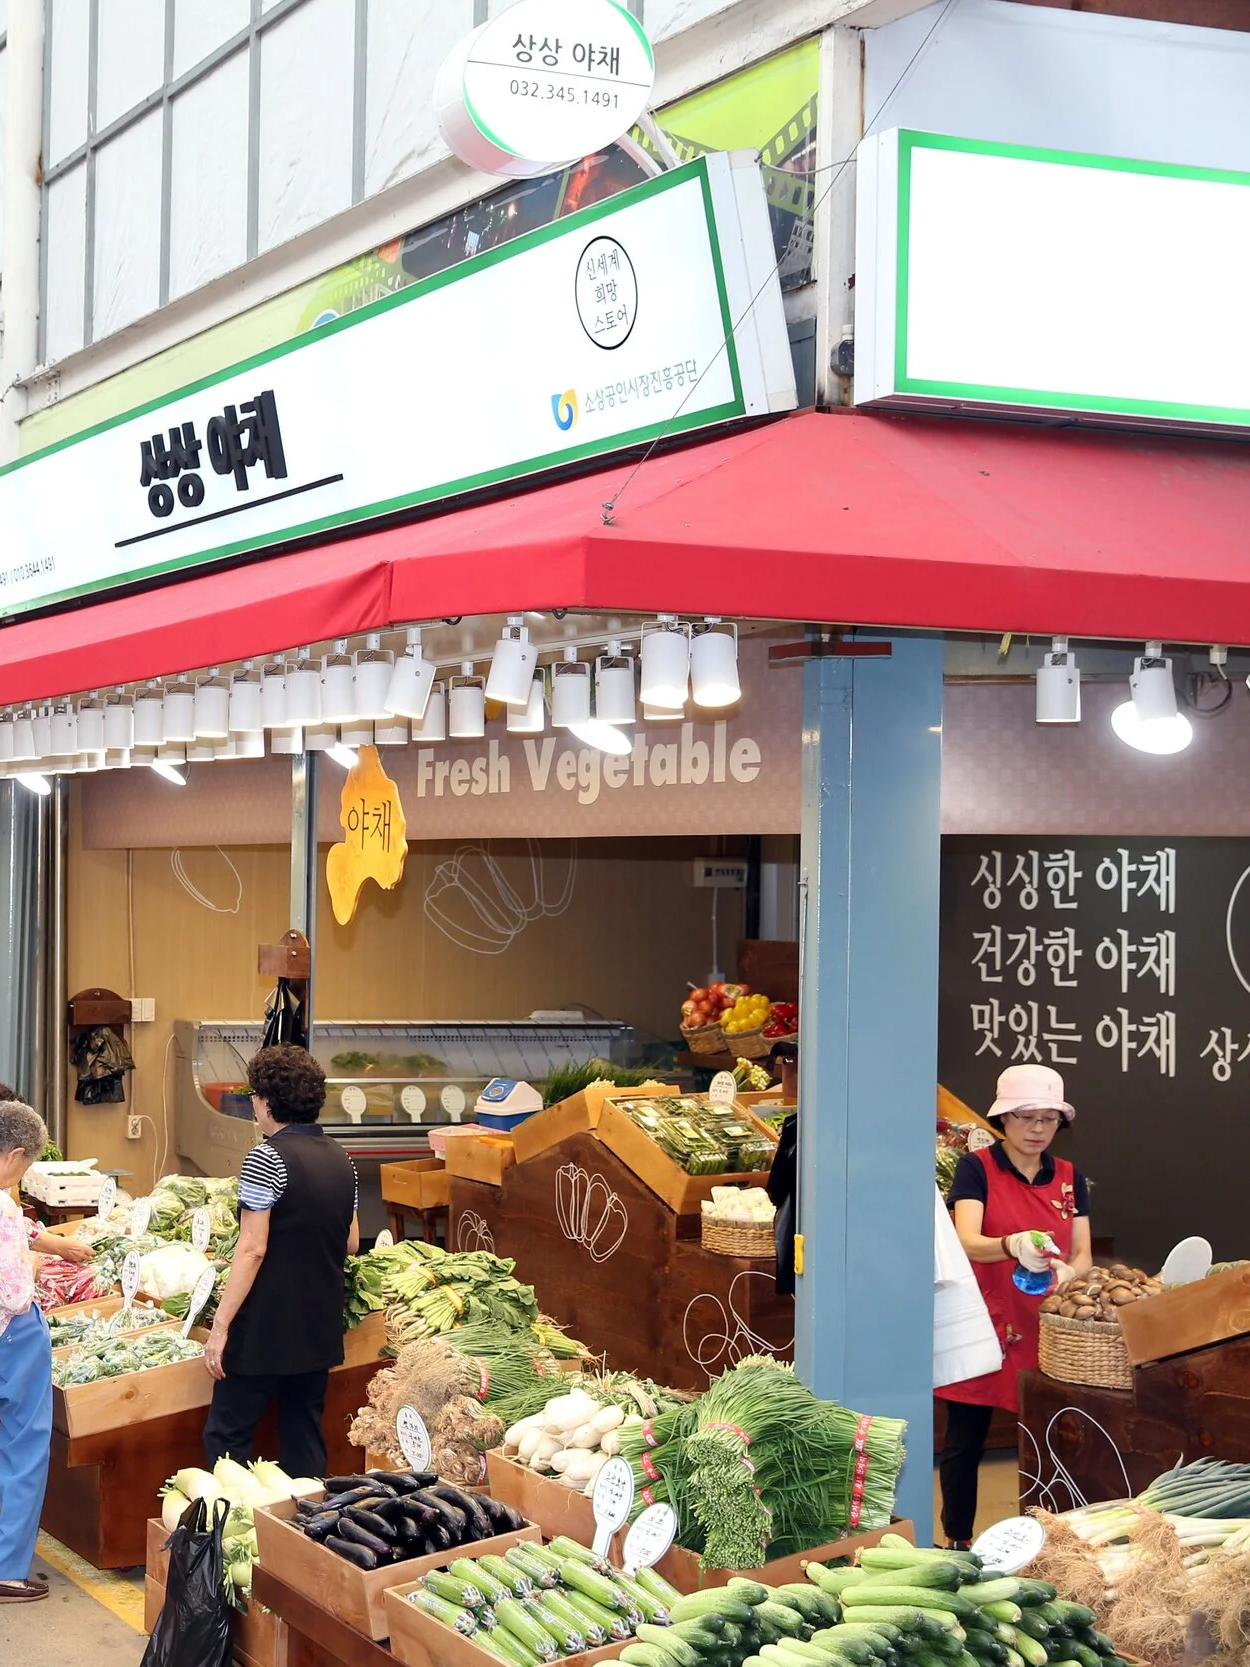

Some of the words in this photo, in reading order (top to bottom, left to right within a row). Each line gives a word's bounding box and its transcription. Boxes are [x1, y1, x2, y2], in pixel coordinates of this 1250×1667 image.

[512, 33, 563, 67] 상상
[572, 42, 620, 76] 야채
[510, 79, 619, 109] 032.345.1491
[585, 248, 621, 281] 신세계
[594, 278, 618, 304] 희망
[593, 303, 629, 334] 스토어
[584, 358, 699, 414] 소상공인시장진흥공단
[139, 420, 205, 518] 상상
[206, 388, 288, 492] 야채
[416, 739, 511, 798] Fresh
[522, 719, 763, 806] Vegetable
[347, 797, 393, 853] 야채
[970, 848, 1083, 911] 싱싱한
[1095, 847, 1177, 914] 야채
[970, 924, 1083, 988] 건강한
[1095, 928, 1177, 997] 야채
[969, 997, 1083, 1065] 맛있는
[1095, 1006, 1177, 1079] 야채
[1199, 1026, 1250, 1082] 상
